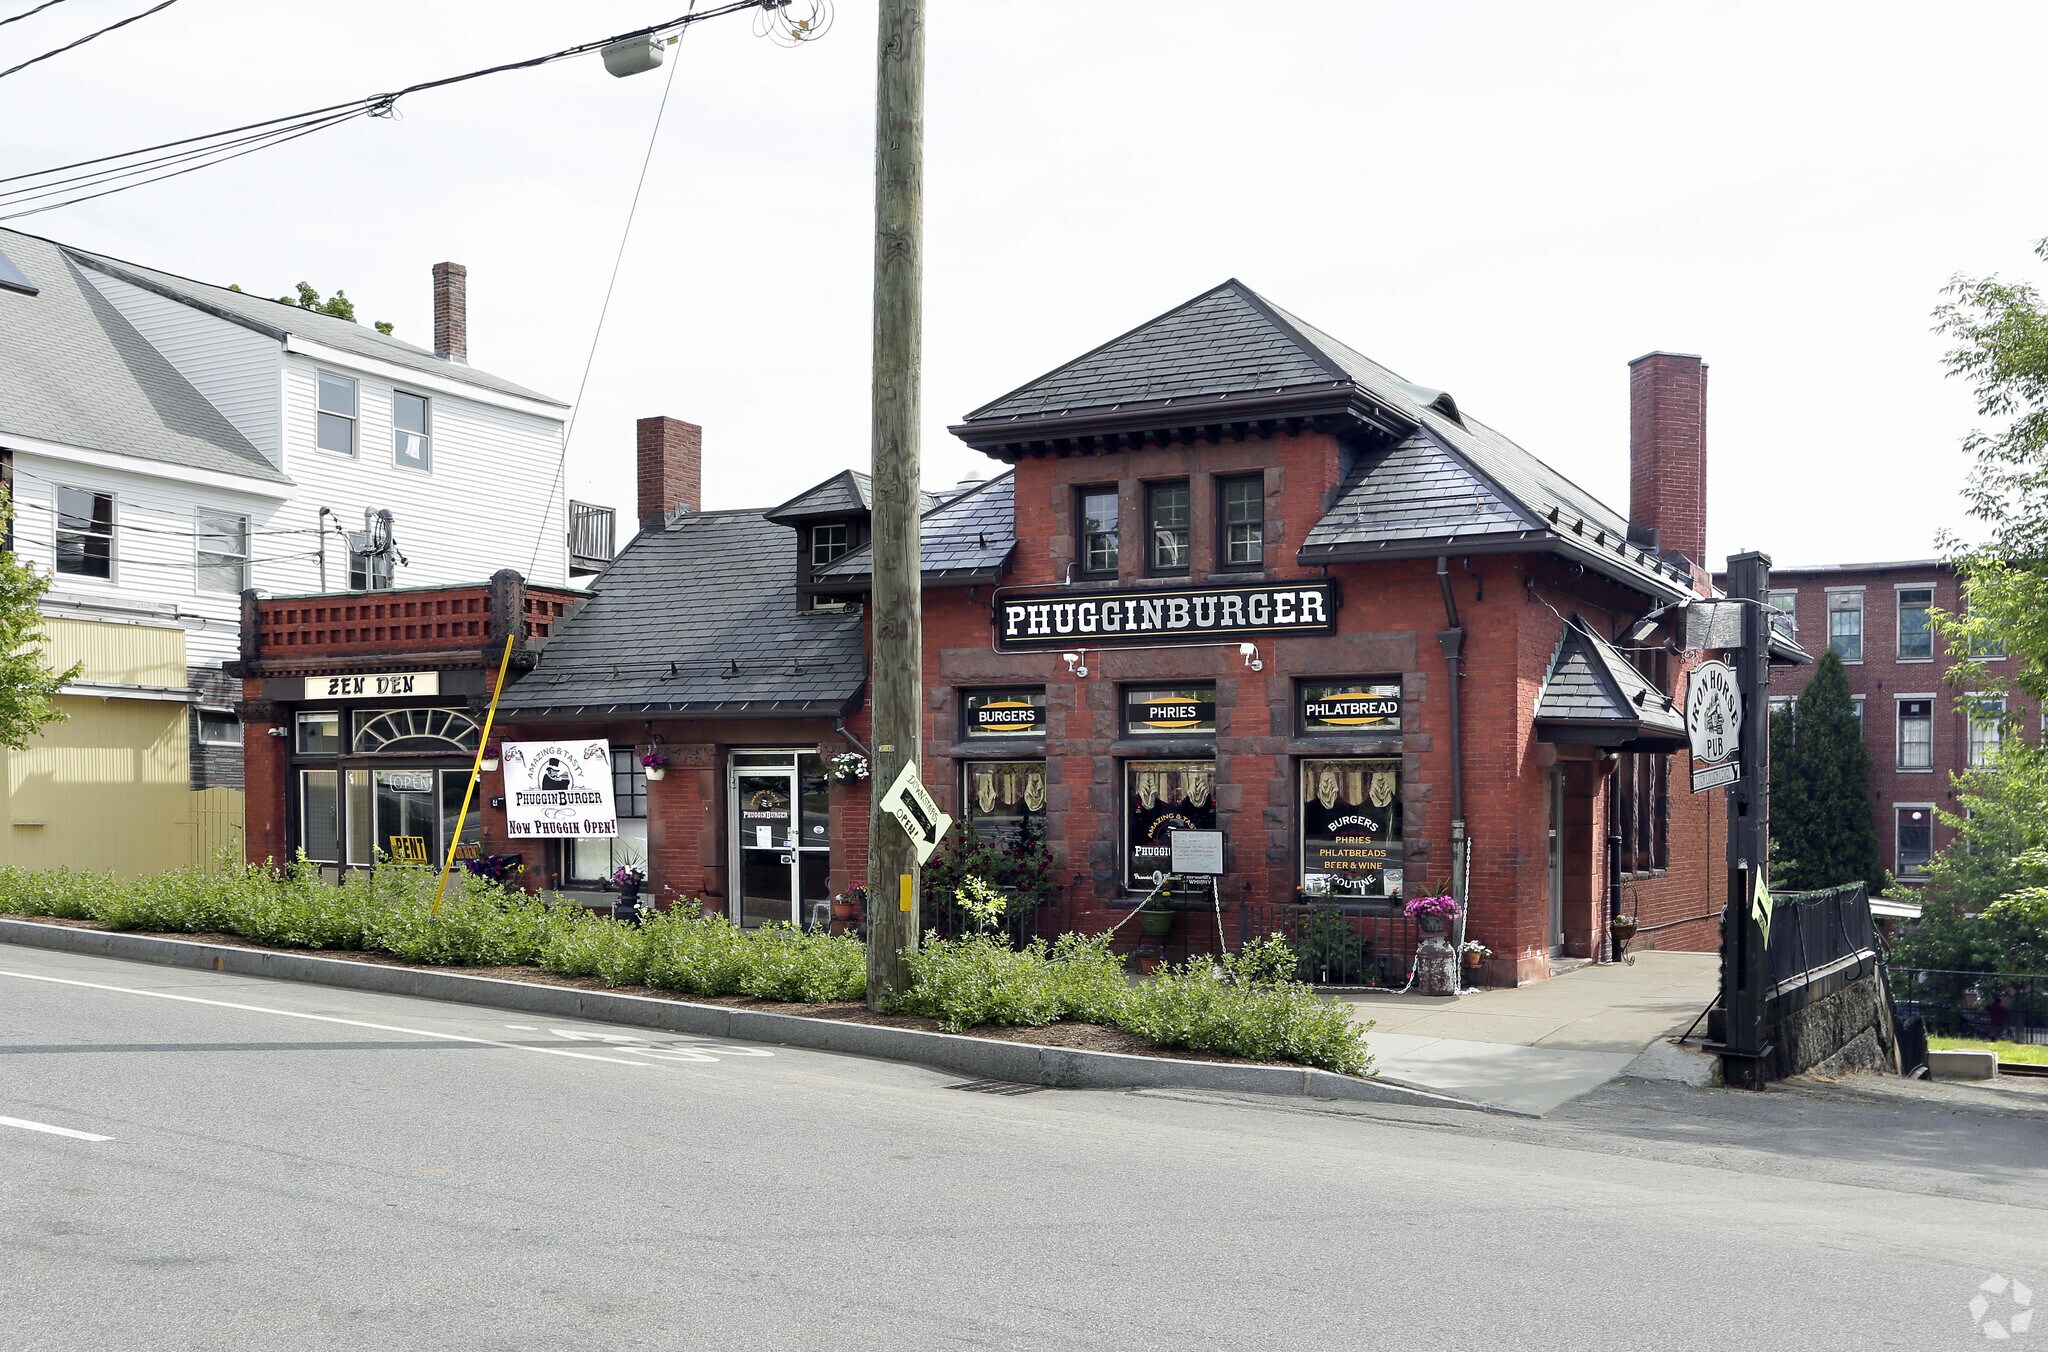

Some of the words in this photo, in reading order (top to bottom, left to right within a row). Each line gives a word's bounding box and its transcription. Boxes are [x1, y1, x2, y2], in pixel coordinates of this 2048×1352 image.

[1006, 591, 1326, 635] PHUGGINBURGER
[328, 677, 365, 695] ZEN
[376, 675, 415, 694] DEN
[1306, 701, 1398, 716] PHLATBREAD
[1691, 675, 1709, 733] IRON
[1710, 671, 1738, 727] HORSE
[979, 710, 1035, 722] BURGERS
[1149, 706, 1196, 718] PHRIES
[1707, 738, 1723, 757] PUB
[528, 746, 555, 779] AMAZING
[556, 747, 563, 755] &
[563, 750, 584, 778] TASTY
[393, 775, 429, 789] OPEN
[896, 808, 919, 839] OPEN!
[1148, 812, 1175, 838] AMAZING
[1183, 816, 1197, 830] TAS
[1328, 815, 1379, 832] BURGERS
[1335, 836, 1371, 844] PHRIES
[1319, 849, 1387, 857] PHLATBREADS
[1324, 861, 1349, 869] BEER
[1358, 862, 1383, 870] WINE
[1328, 873, 1376, 889] POUTINE
